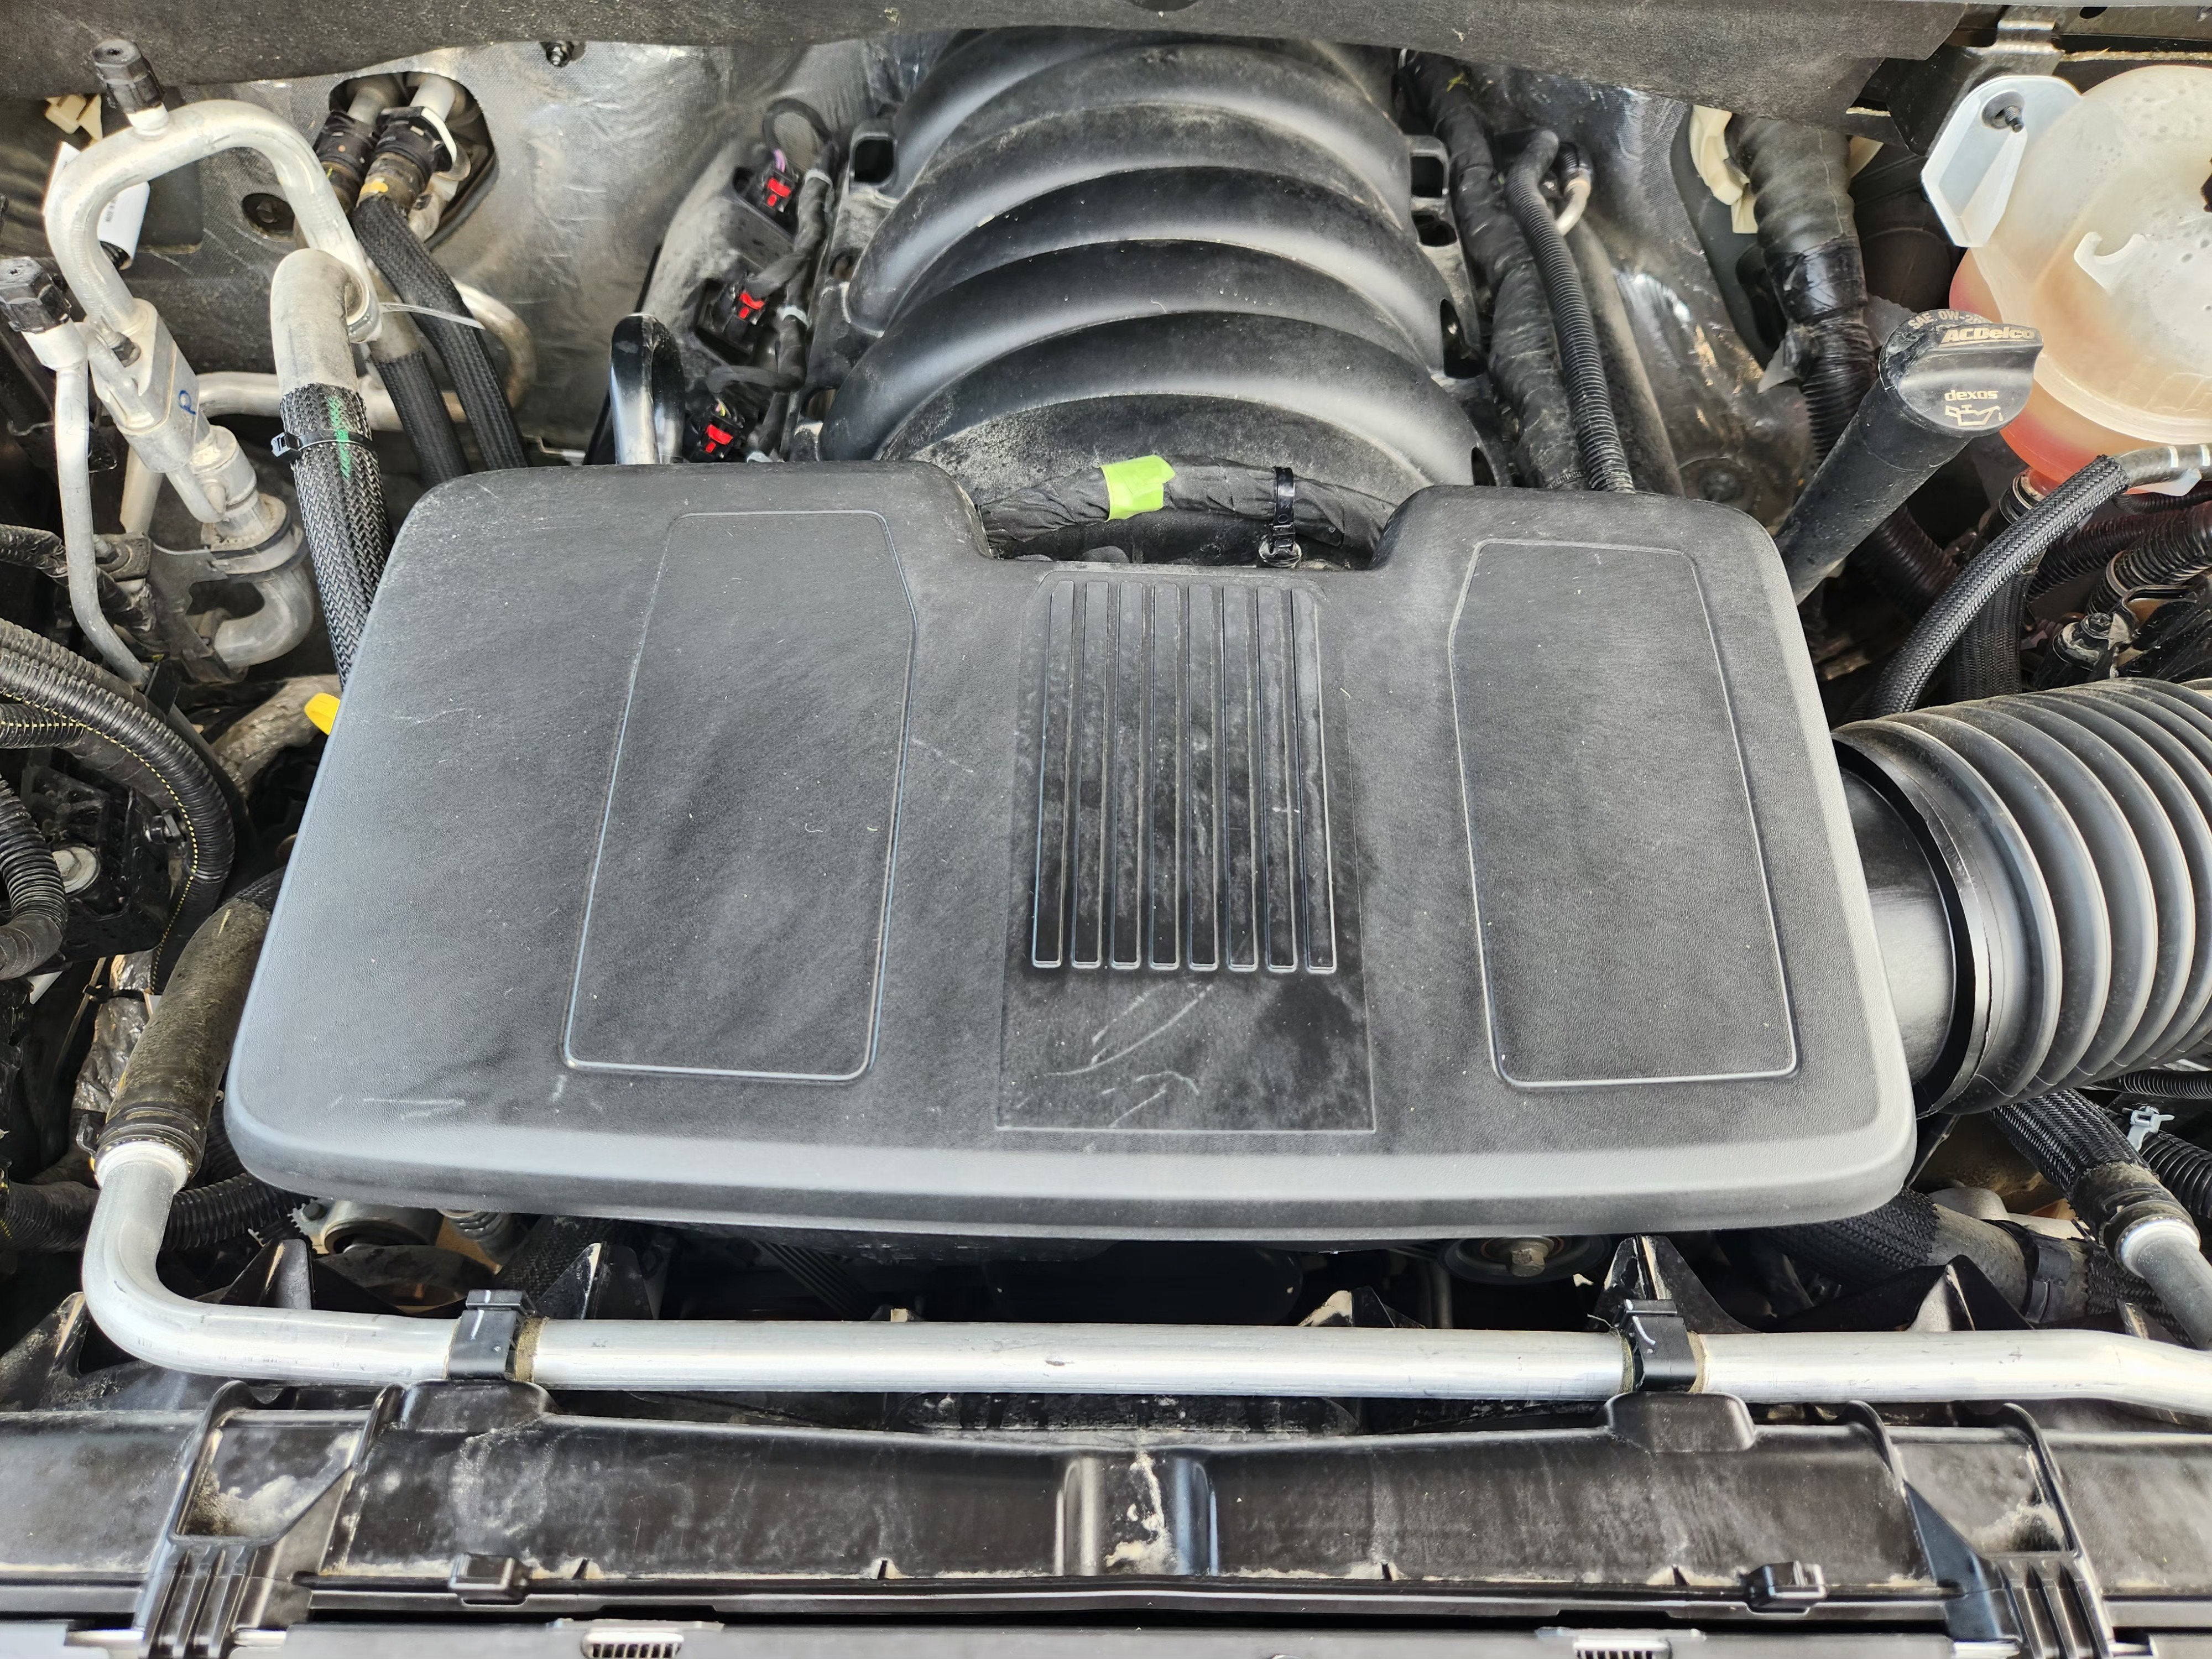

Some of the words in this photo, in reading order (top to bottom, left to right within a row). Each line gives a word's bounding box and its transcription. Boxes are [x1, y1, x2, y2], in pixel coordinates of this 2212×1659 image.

[1908, 312, 1934, 330] SAE
[1940, 327, 2035, 343] ACDelco
[1944, 389, 1999, 401] dexos
